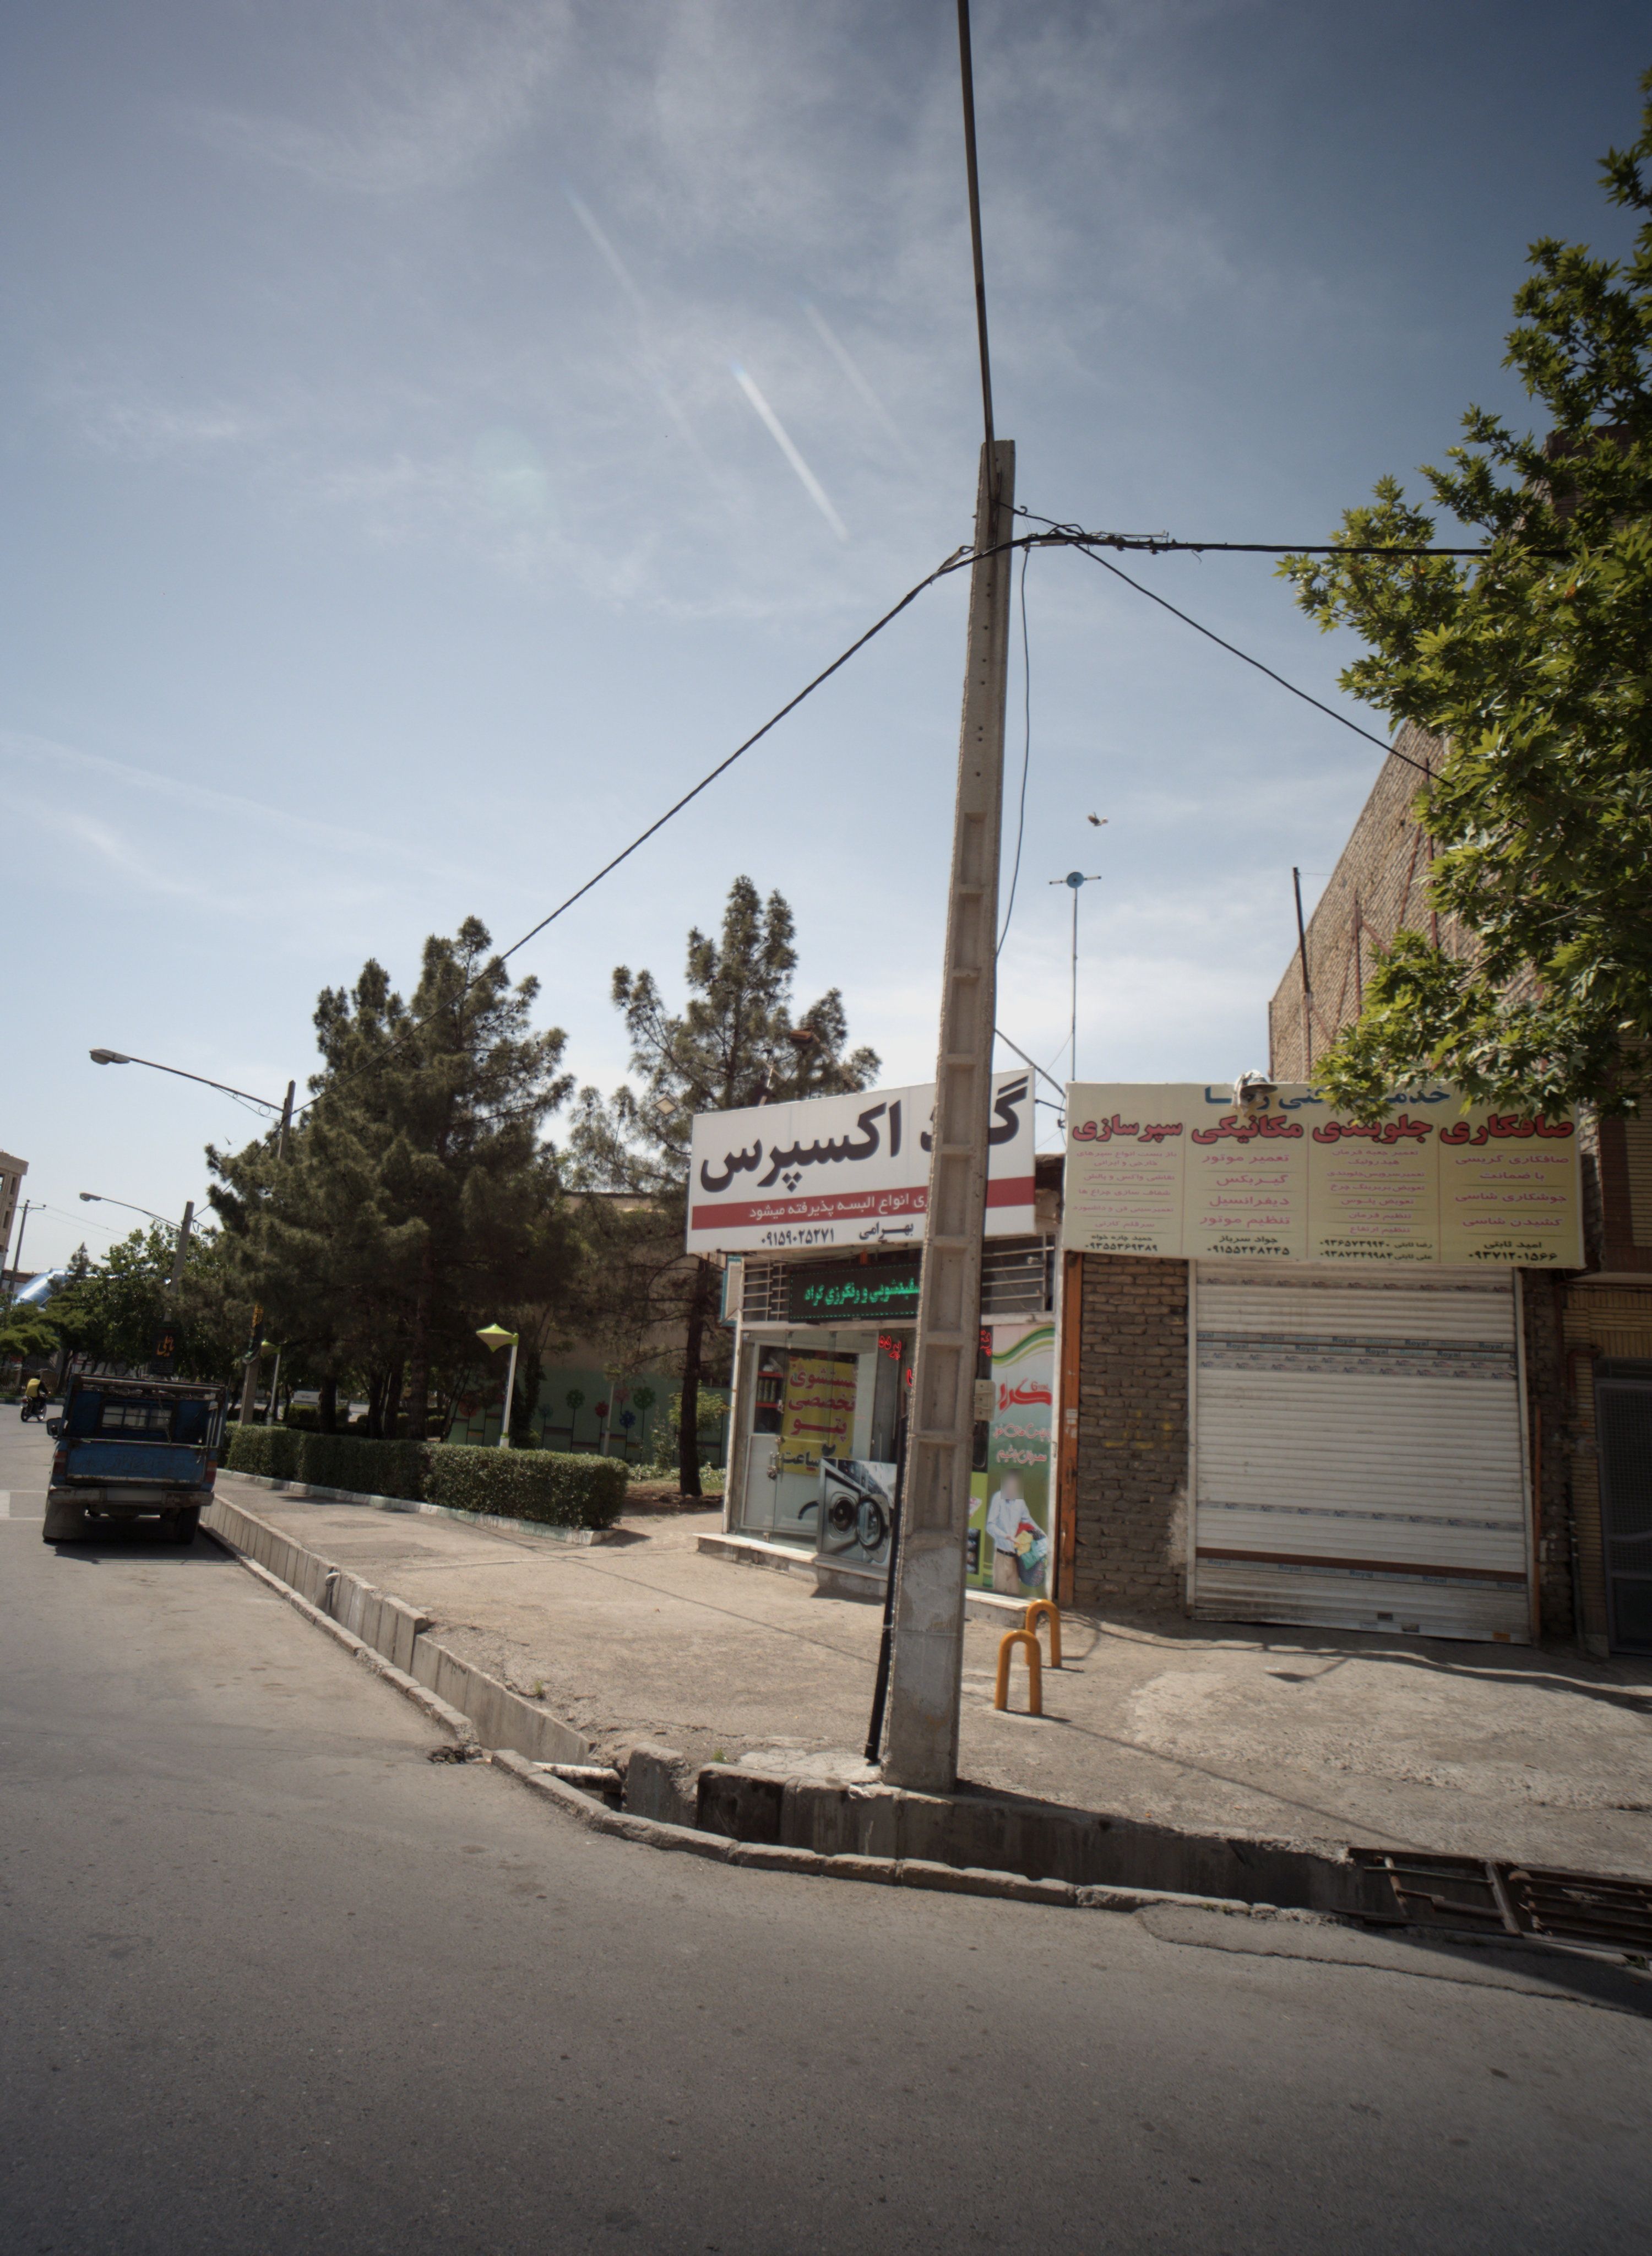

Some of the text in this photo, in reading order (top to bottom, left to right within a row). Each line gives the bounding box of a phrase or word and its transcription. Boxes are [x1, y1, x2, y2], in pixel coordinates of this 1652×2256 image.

[1204, 1086, 1270, 1110] را
[1192, 1115, 1303, 1145] مکانیکی
[1312, 1113, 1433, 1144] جلوبندی
[1440, 1113, 1575, 1145] صافکاری
[700, 1100, 901, 1193] اکسپرس
[1202, 1154, 1290, 1165] تعمیر موتور
[1509, 1155, 1569, 1165] صافکاری
[1480, 1172, 1545, 1181] با ضمانت
[837, 1196, 875, 1213] البسه
[879, 1193, 909, 1214] انواع
[1209, 1196, 1290, 1207] دیفرانسیل
[1455, 1192, 1567, 1204] جوشکاری شاسی
[749, 1206, 785, 1221] میشود
[1382, 1213, 1412, 1221] تنظیم
[1199, 1216, 1291, 1228] تنظیم موتور
[1462, 1217, 1563, 1227] کشیدن شاسی
[858, 1221, 914, 1241] بهرامی
[1381, 1227, 1411, 1235] تنظیم
[1254, 1237, 1278, 1245] جواد
[1333, 1336, 1356, 1344] Royal
[1405, 1339, 1430, 1347] Royal
[1365, 1347, 1388, 1355] Royal
[1437, 1350, 1461, 1358] Royal
[789, 1393, 857, 1412] تخصصی
[790, 1418, 847, 1442] پتو
[1278, 1564, 1301, 1572] Royal
[1349, 1570, 1373, 1579] Royal
[1422, 1576, 1447, 1585] Royal
[1497, 1582, 1521, 1590] Royal
